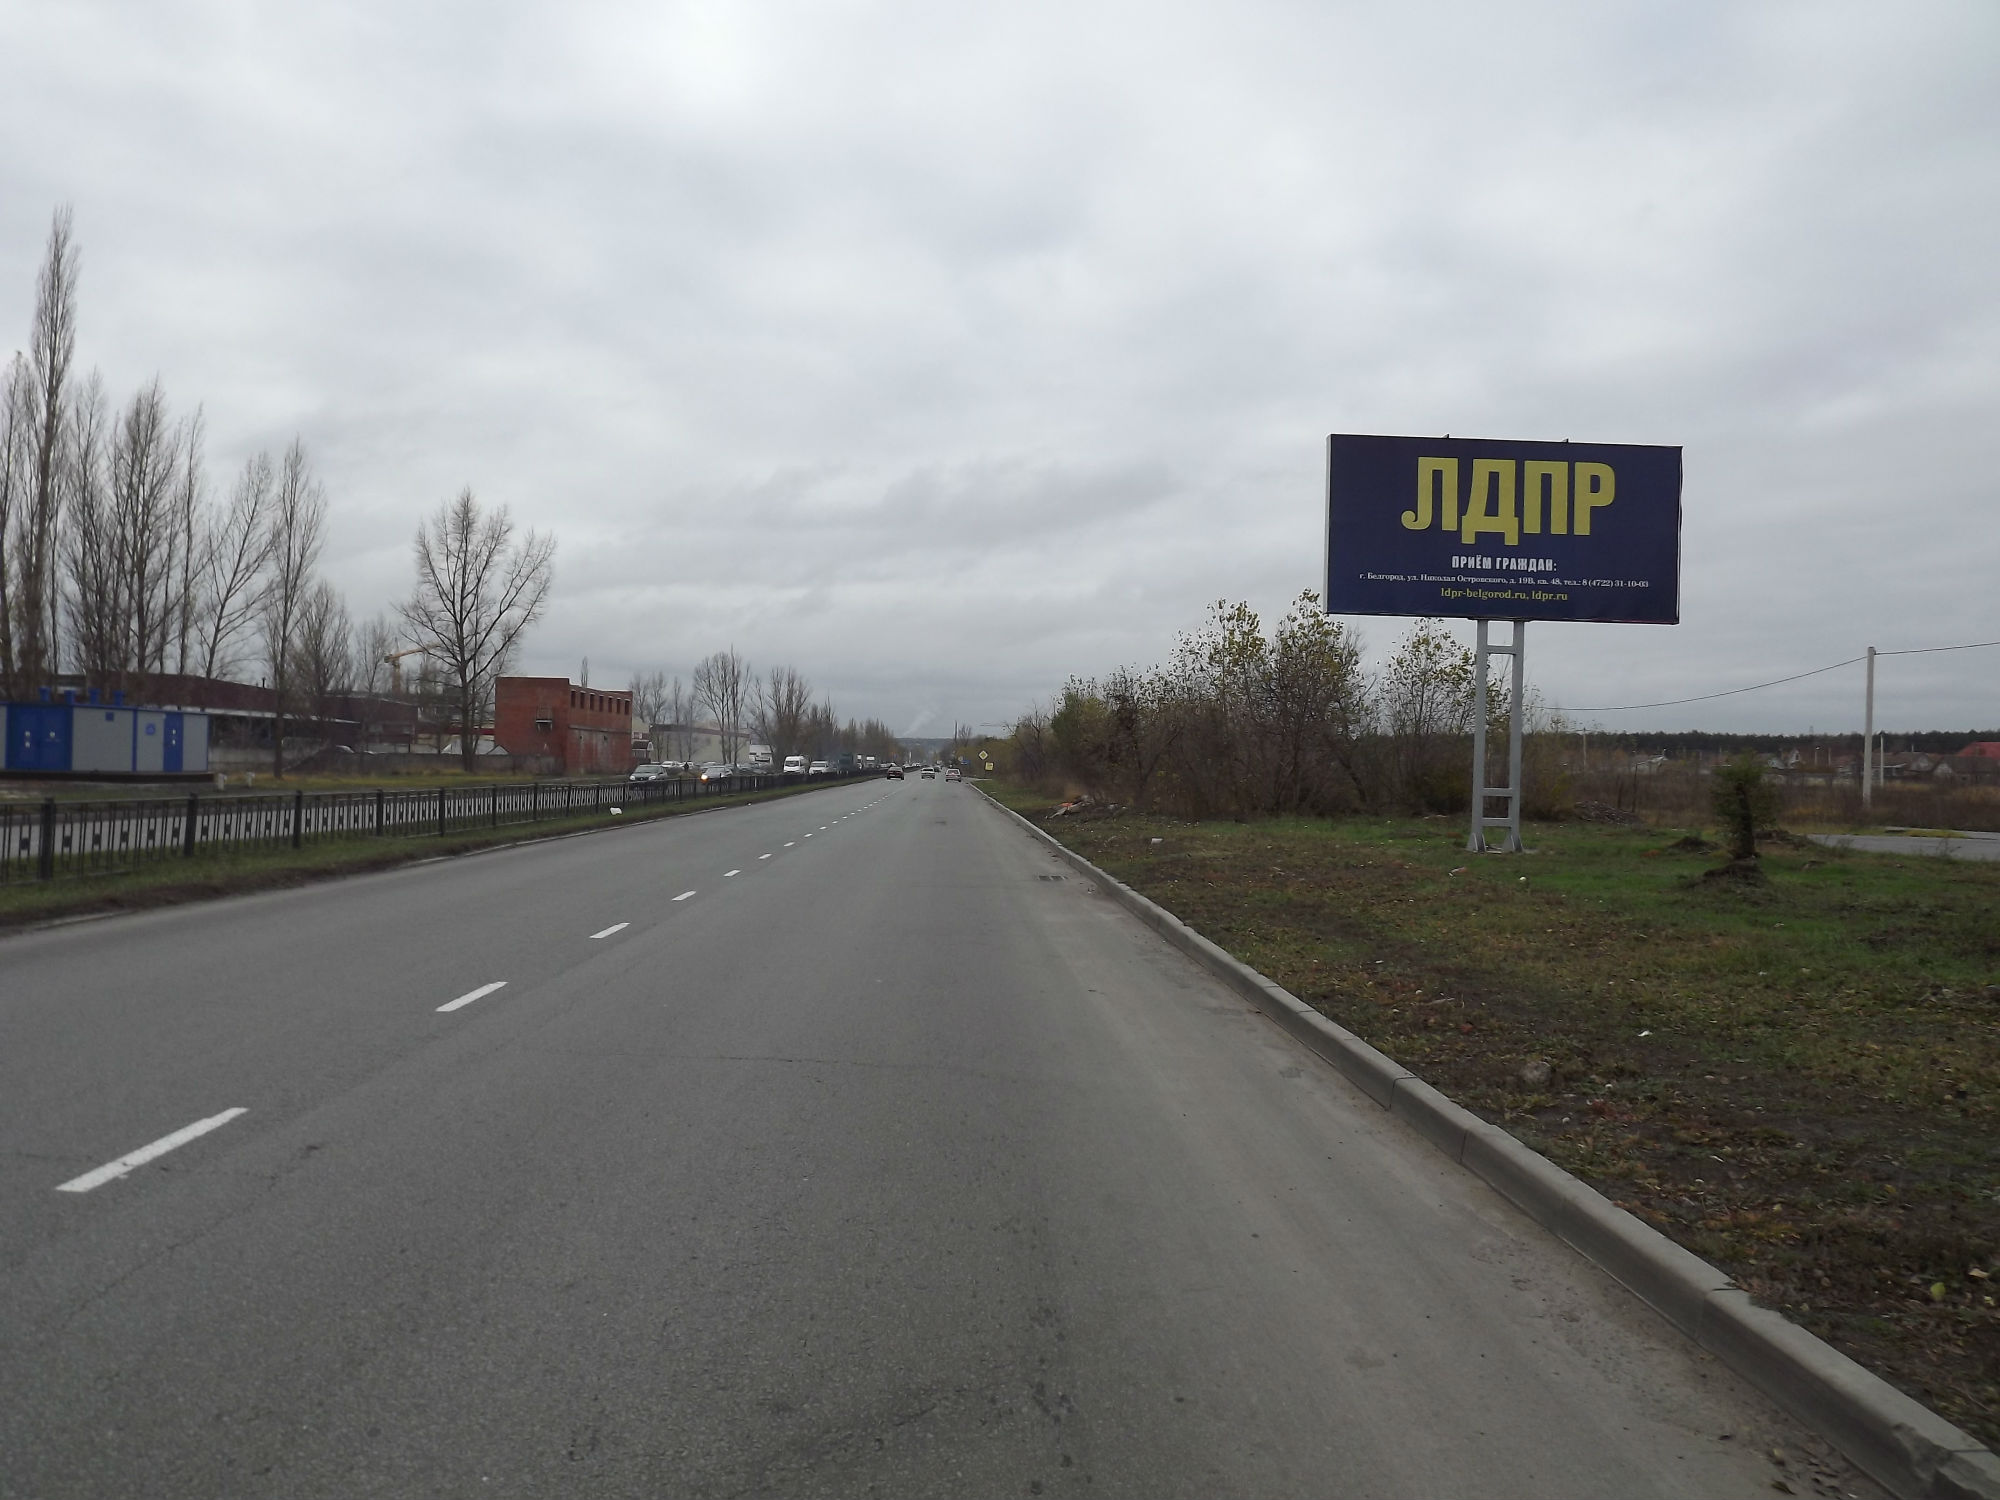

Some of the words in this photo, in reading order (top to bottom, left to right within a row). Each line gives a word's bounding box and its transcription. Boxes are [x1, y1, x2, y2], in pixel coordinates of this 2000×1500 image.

[1401, 456, 1616, 546] ЛДПР
[1451, 554, 1492, 570] ПРИЁМ
[1496, 557, 1557, 572] ГРАЖДАН:
[1420, 574, 1456, 582] Николая
[1588, 579, 1613, 588] (4722)
[1532, 590, 1568, 602] ldpr.ru
